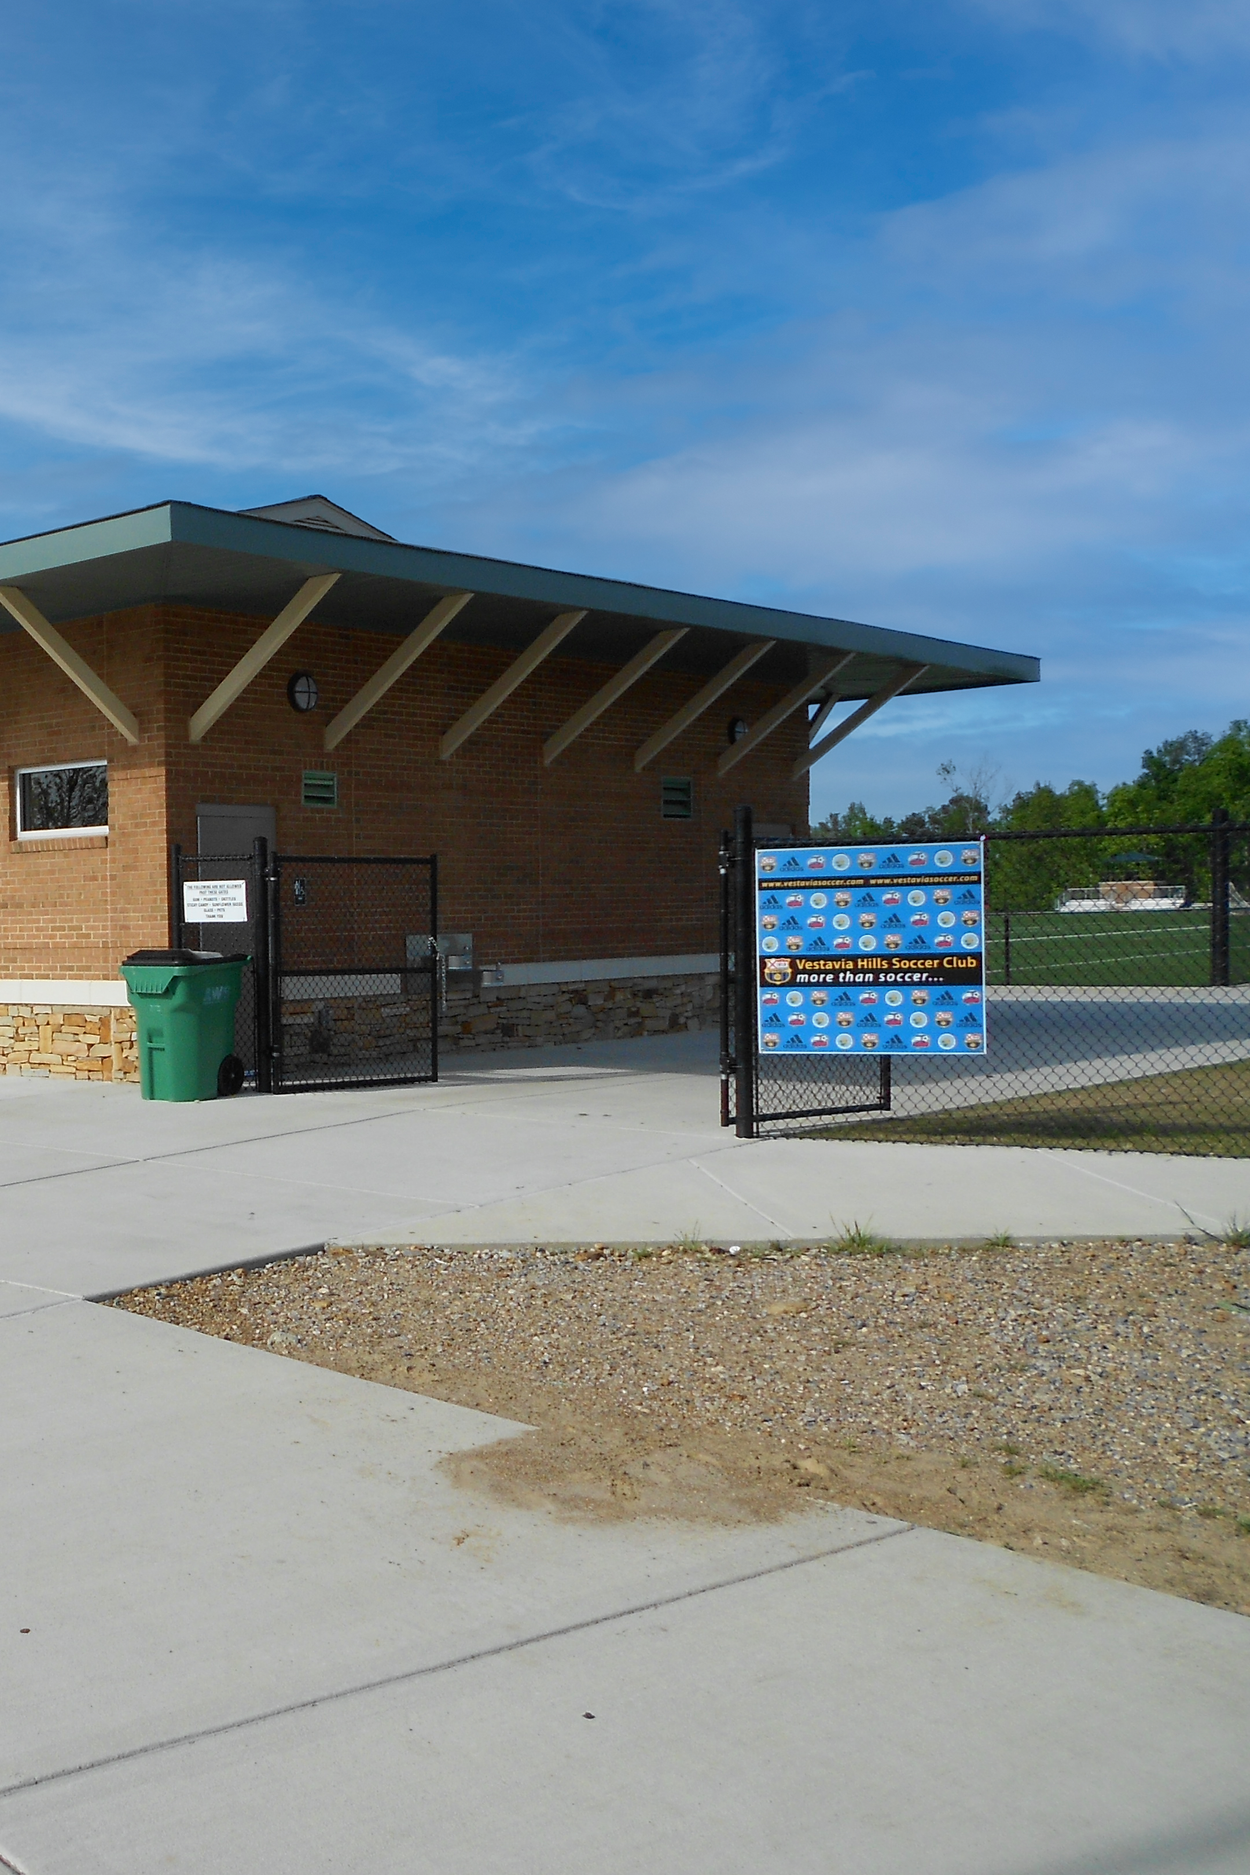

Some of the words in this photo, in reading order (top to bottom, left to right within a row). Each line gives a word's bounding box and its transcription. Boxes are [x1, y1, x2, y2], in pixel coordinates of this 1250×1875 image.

[761, 879, 864, 888] www.vestaviasoccer.com
[869, 875, 978, 885] www.vestaviasoccer.com
[795, 958, 854, 970] Vestavia
[857, 957, 889, 969] Hills
[891, 957, 940, 969] Soccer
[942, 956, 977, 968] Club
[795, 973, 834, 983] more
[838, 971, 874, 982] than
[878, 972, 944, 982] soccer...
